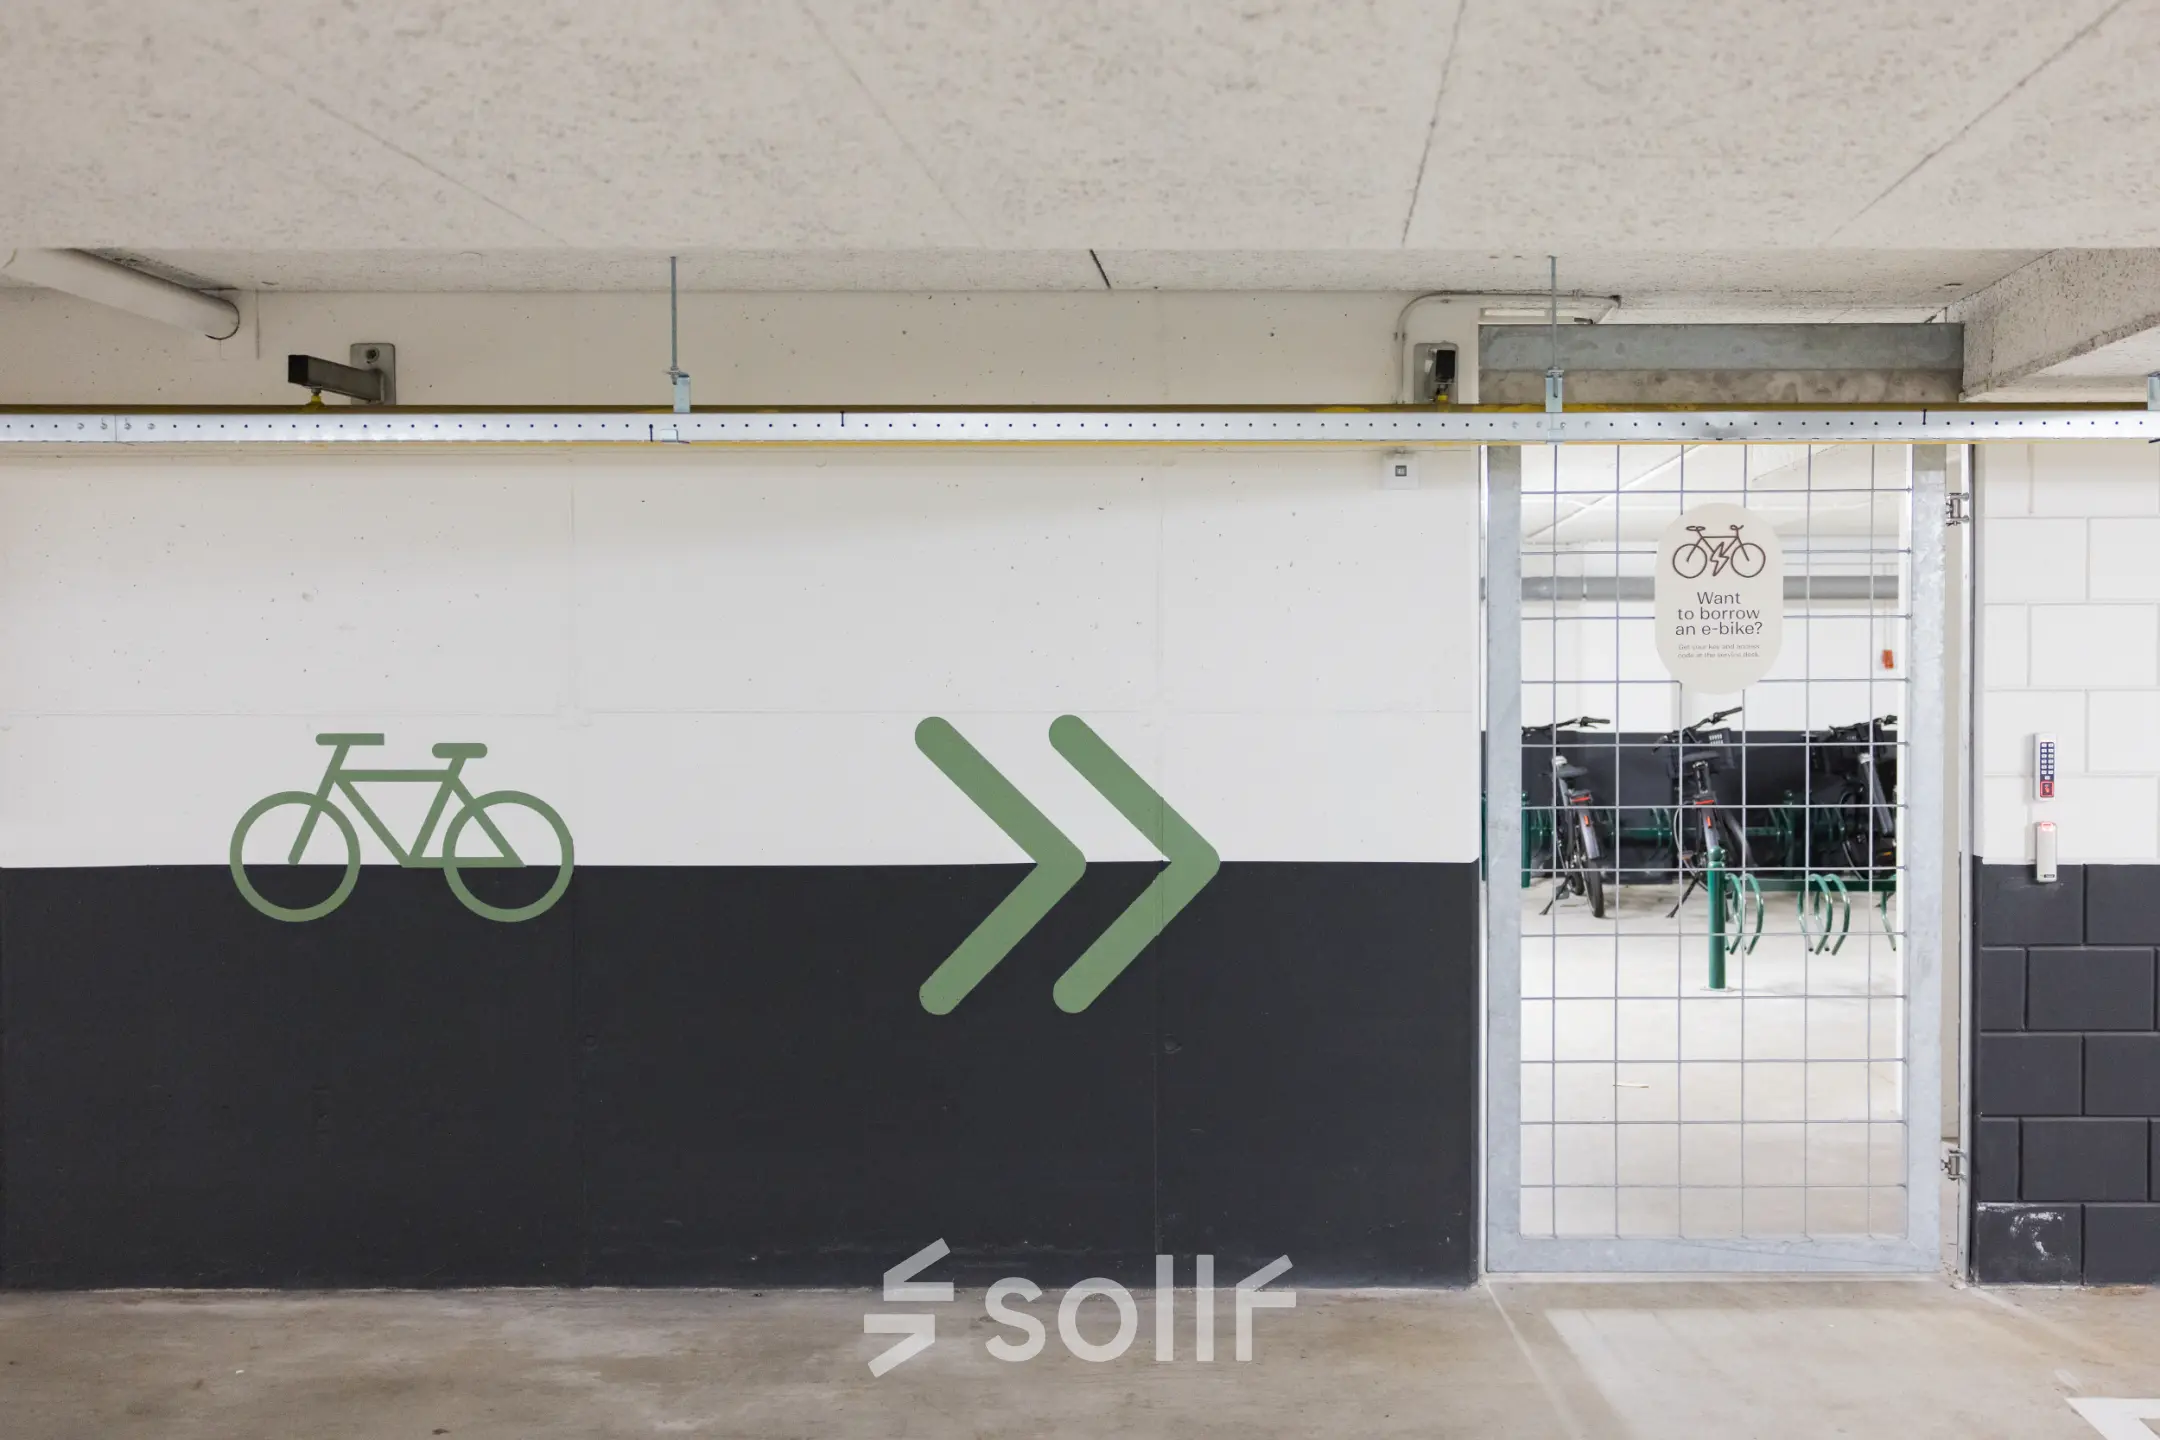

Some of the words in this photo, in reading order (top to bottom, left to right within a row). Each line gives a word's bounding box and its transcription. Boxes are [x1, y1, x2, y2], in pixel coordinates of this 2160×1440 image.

[1697, 591, 1741, 604] Want
[1678, 609, 1694, 620] to
[1700, 606, 1760, 620] borrow
[1675, 625, 1696, 635] an
[1701, 621, 1763, 635] e-bike?
